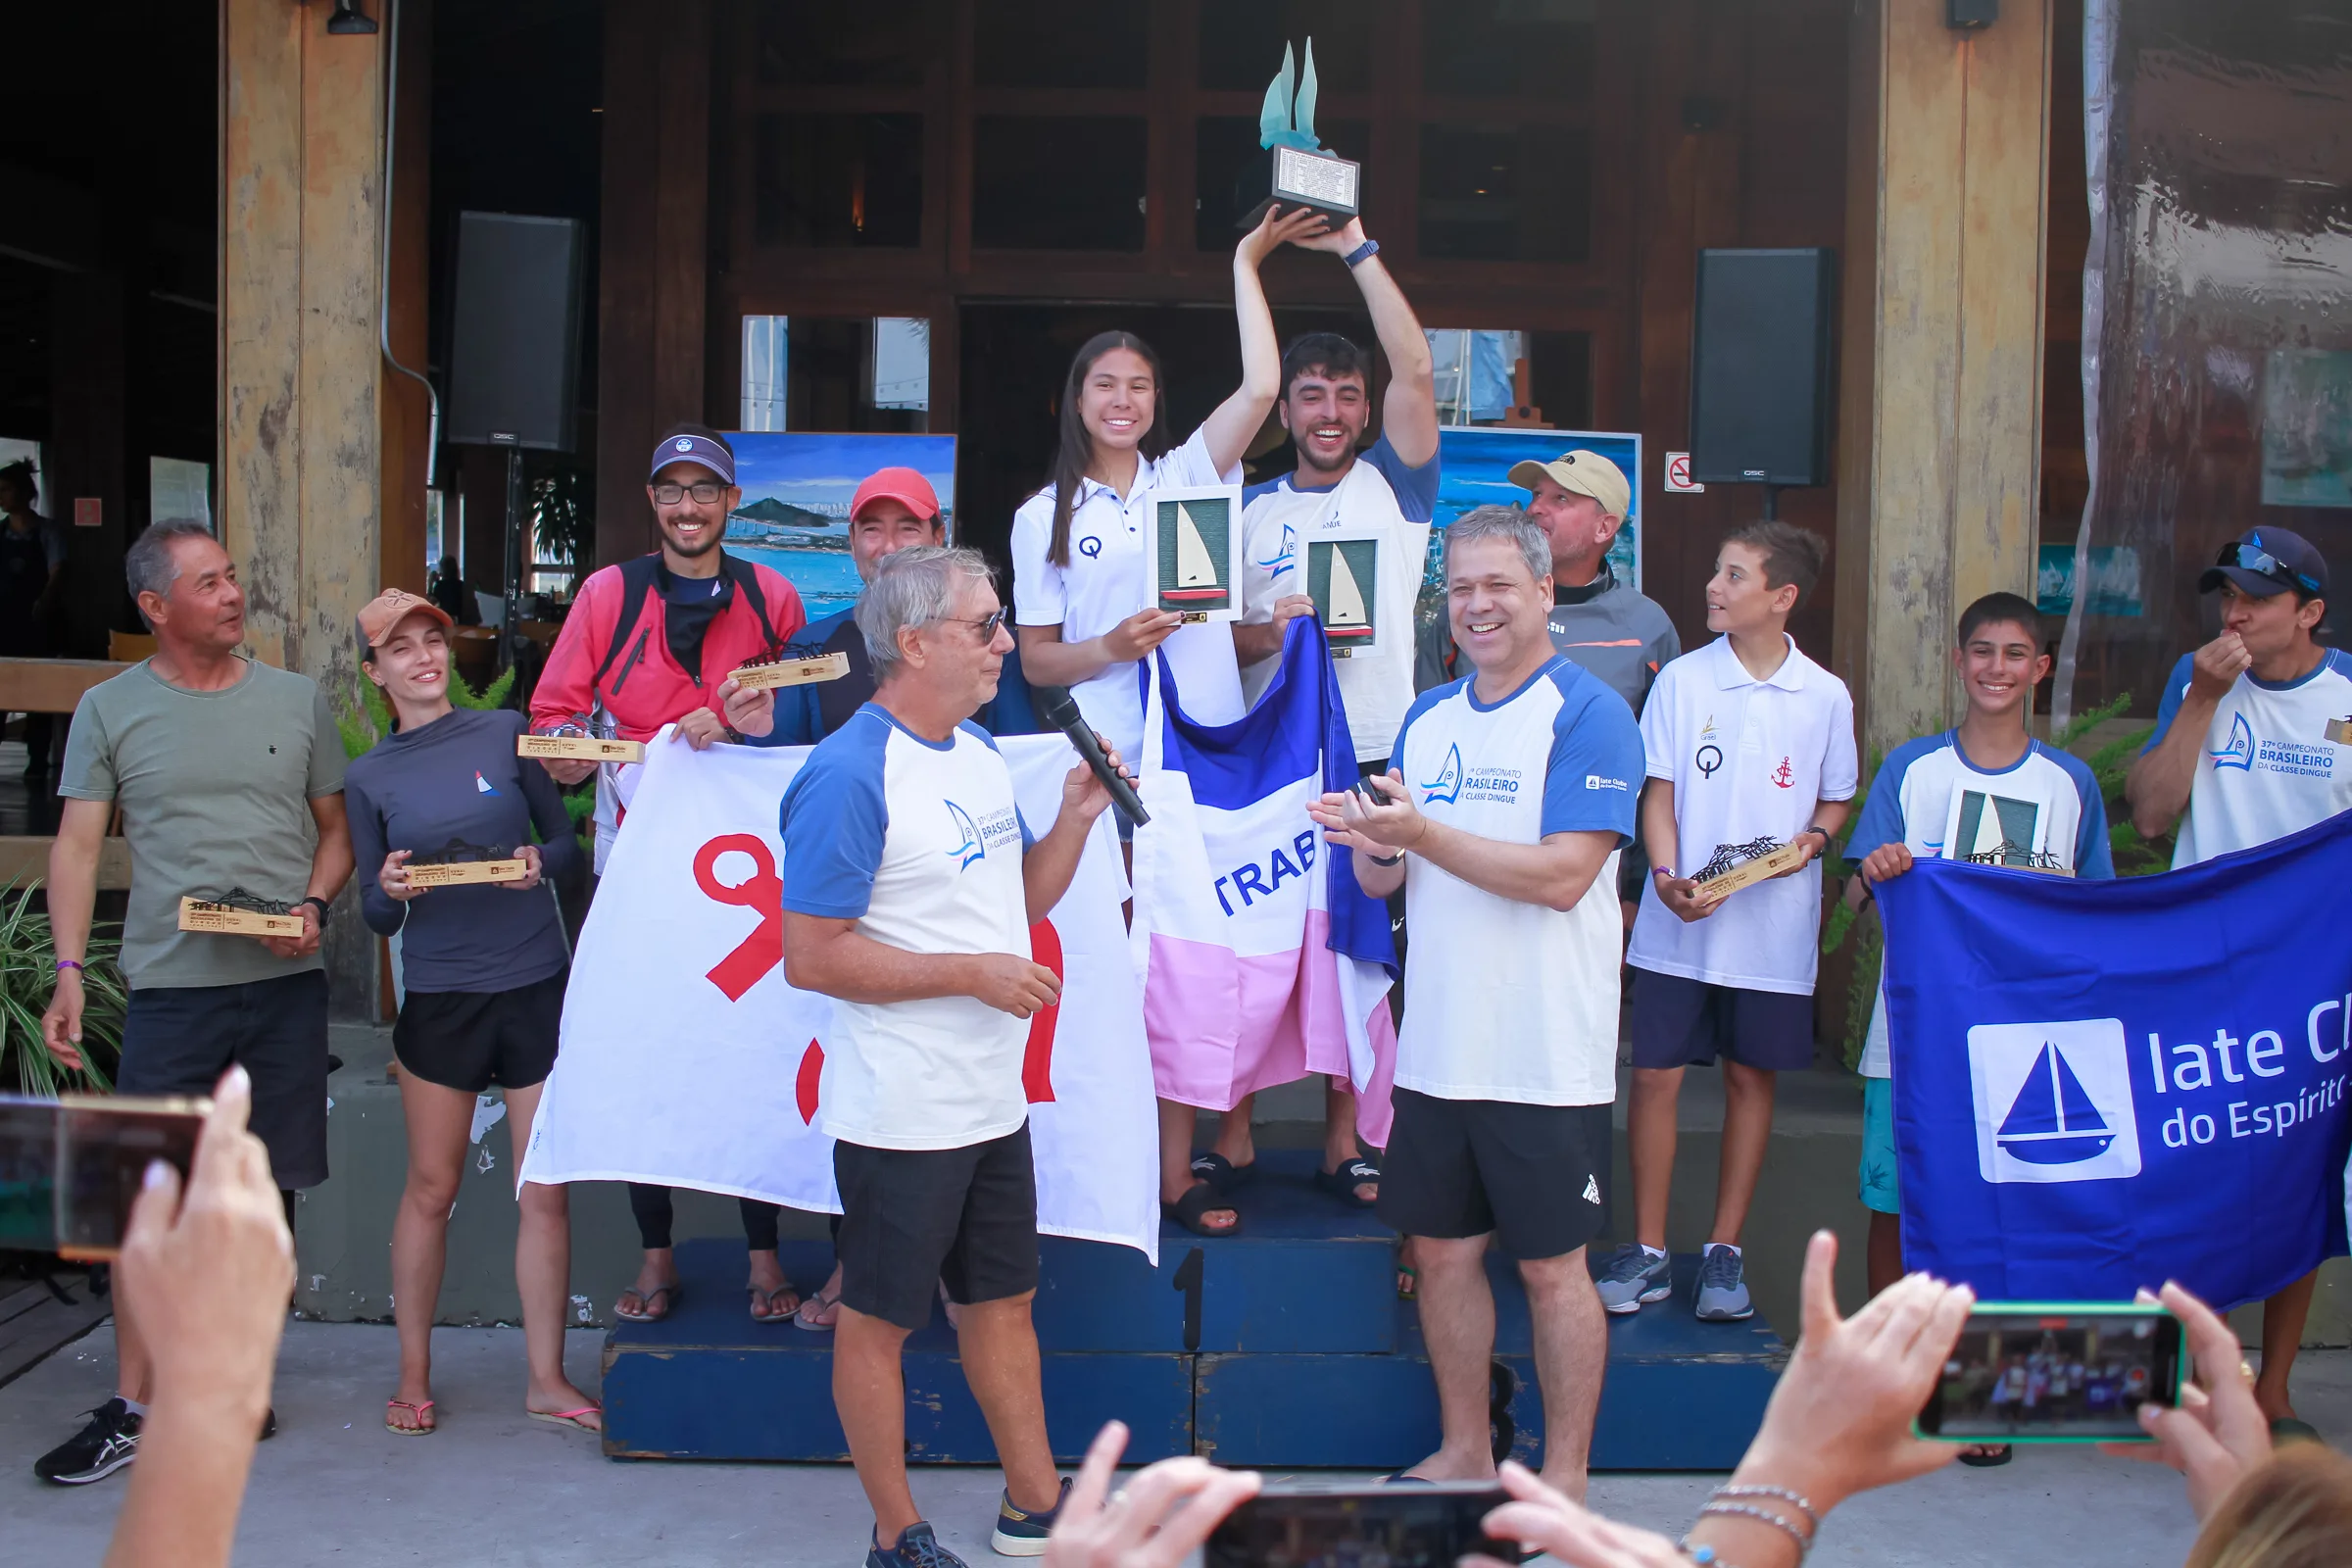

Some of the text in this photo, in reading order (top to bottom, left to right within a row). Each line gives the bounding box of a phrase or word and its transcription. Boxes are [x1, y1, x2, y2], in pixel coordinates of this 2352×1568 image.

[1547, 621, 1565, 634] ill
[2277, 742, 2334, 756] CAMPEONATO
[2259, 749, 2333, 768] BRASILEIRO
[1475, 767, 1522, 779] CAMPEONATO
[2270, 764, 2299, 775] CLASSE
[2300, 768, 2332, 778] DINGUE
[1464, 777, 1519, 793] RASILEIRO
[1487, 793, 1516, 805] DINGUE
[993, 834, 1011, 849] CLASSE
[2148, 1028, 2285, 1094] Iate
[2162, 1106, 2216, 1149] do
[1173, 1247, 1204, 1351] 1
